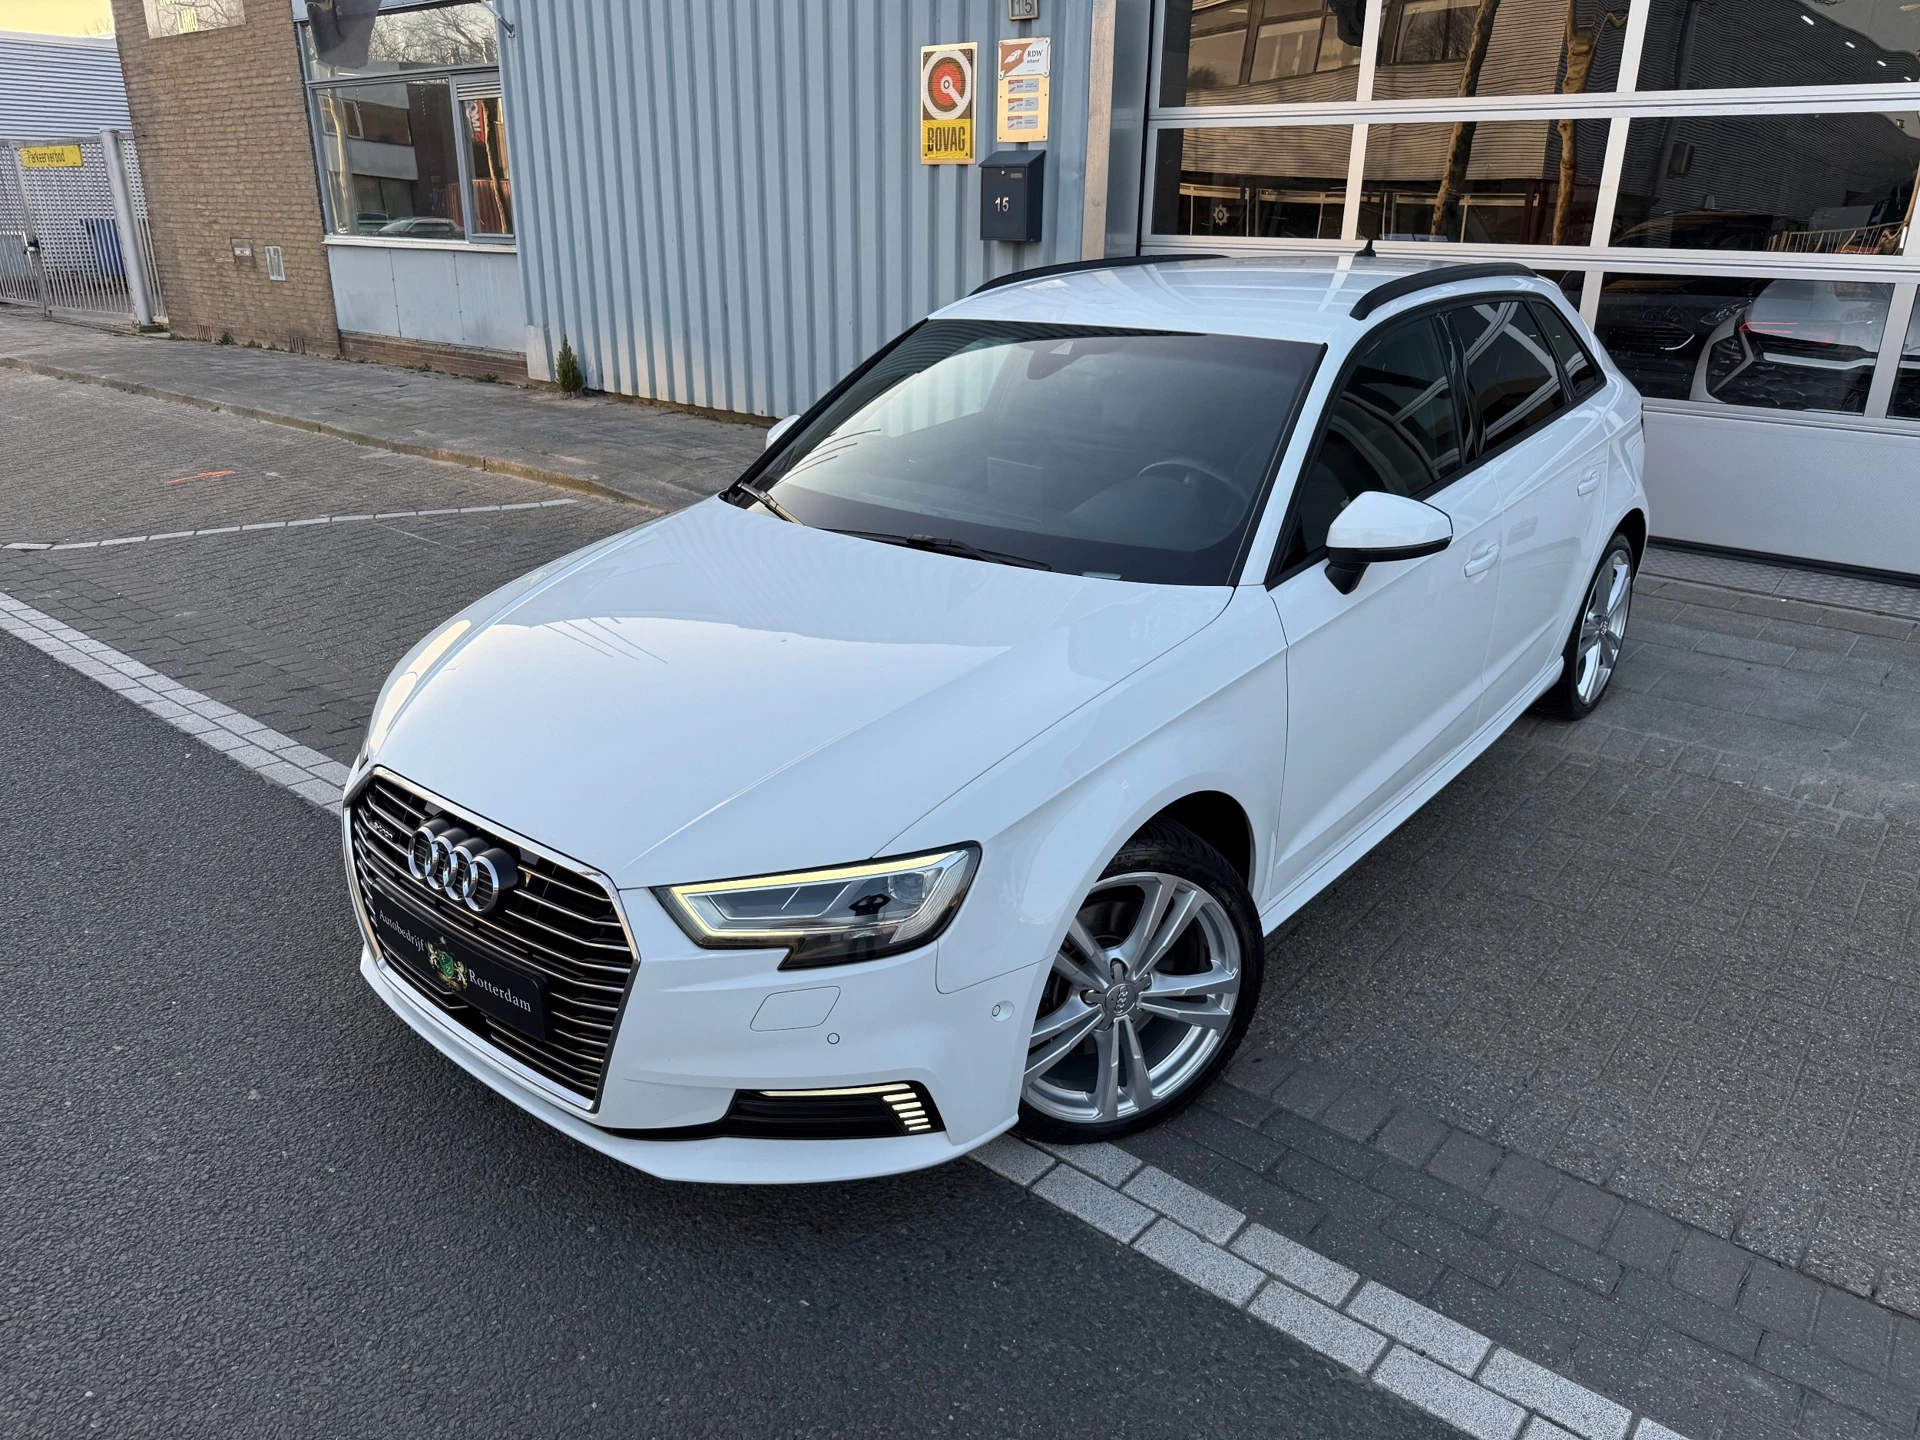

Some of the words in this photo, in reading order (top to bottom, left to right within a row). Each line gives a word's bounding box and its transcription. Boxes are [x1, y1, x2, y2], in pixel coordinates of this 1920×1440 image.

[1015, 0, 1033, 14] 15
[1027, 50, 1043, 58] RDW
[927, 126, 966, 152] BOVAG
[995, 197, 1010, 212] 15
[379, 909, 425, 952] Autobedrijf
[468, 969, 532, 1013] Rotterdam
